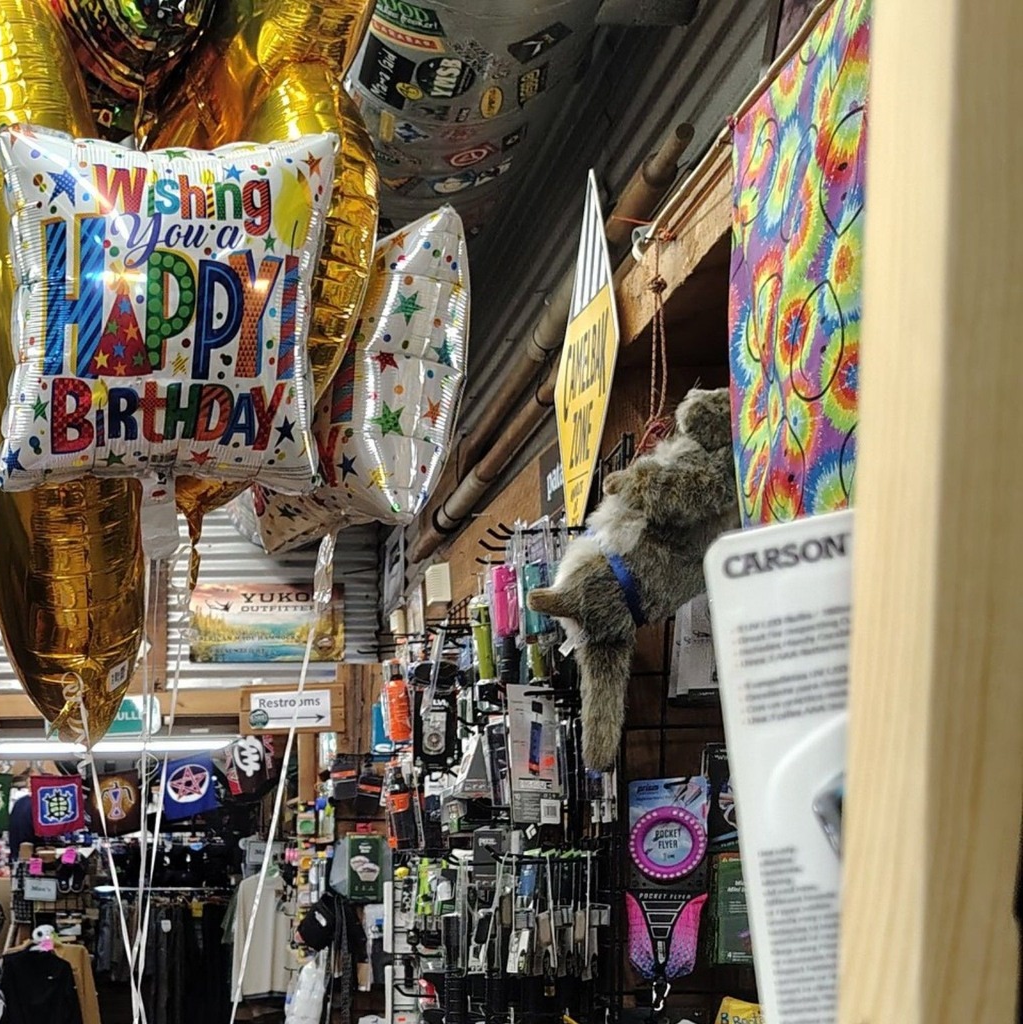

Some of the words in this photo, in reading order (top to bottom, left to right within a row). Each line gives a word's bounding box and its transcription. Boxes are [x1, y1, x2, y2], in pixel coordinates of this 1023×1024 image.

[431, 58, 463, 98] YMSB
[92, 163, 272, 237] Wishing
[110, 212, 209, 269] You
[216, 224, 242, 250] a
[41, 212, 285, 381] HAPPY
[563, 306, 609, 423] CAMELBAK
[569, 400, 594, 470] ZONE
[723, 535, 845, 579] CARSON
[241, 592, 315, 603] YUKO
[654, 828, 682, 839] POCKET
[658, 840, 679, 850] FLYER
